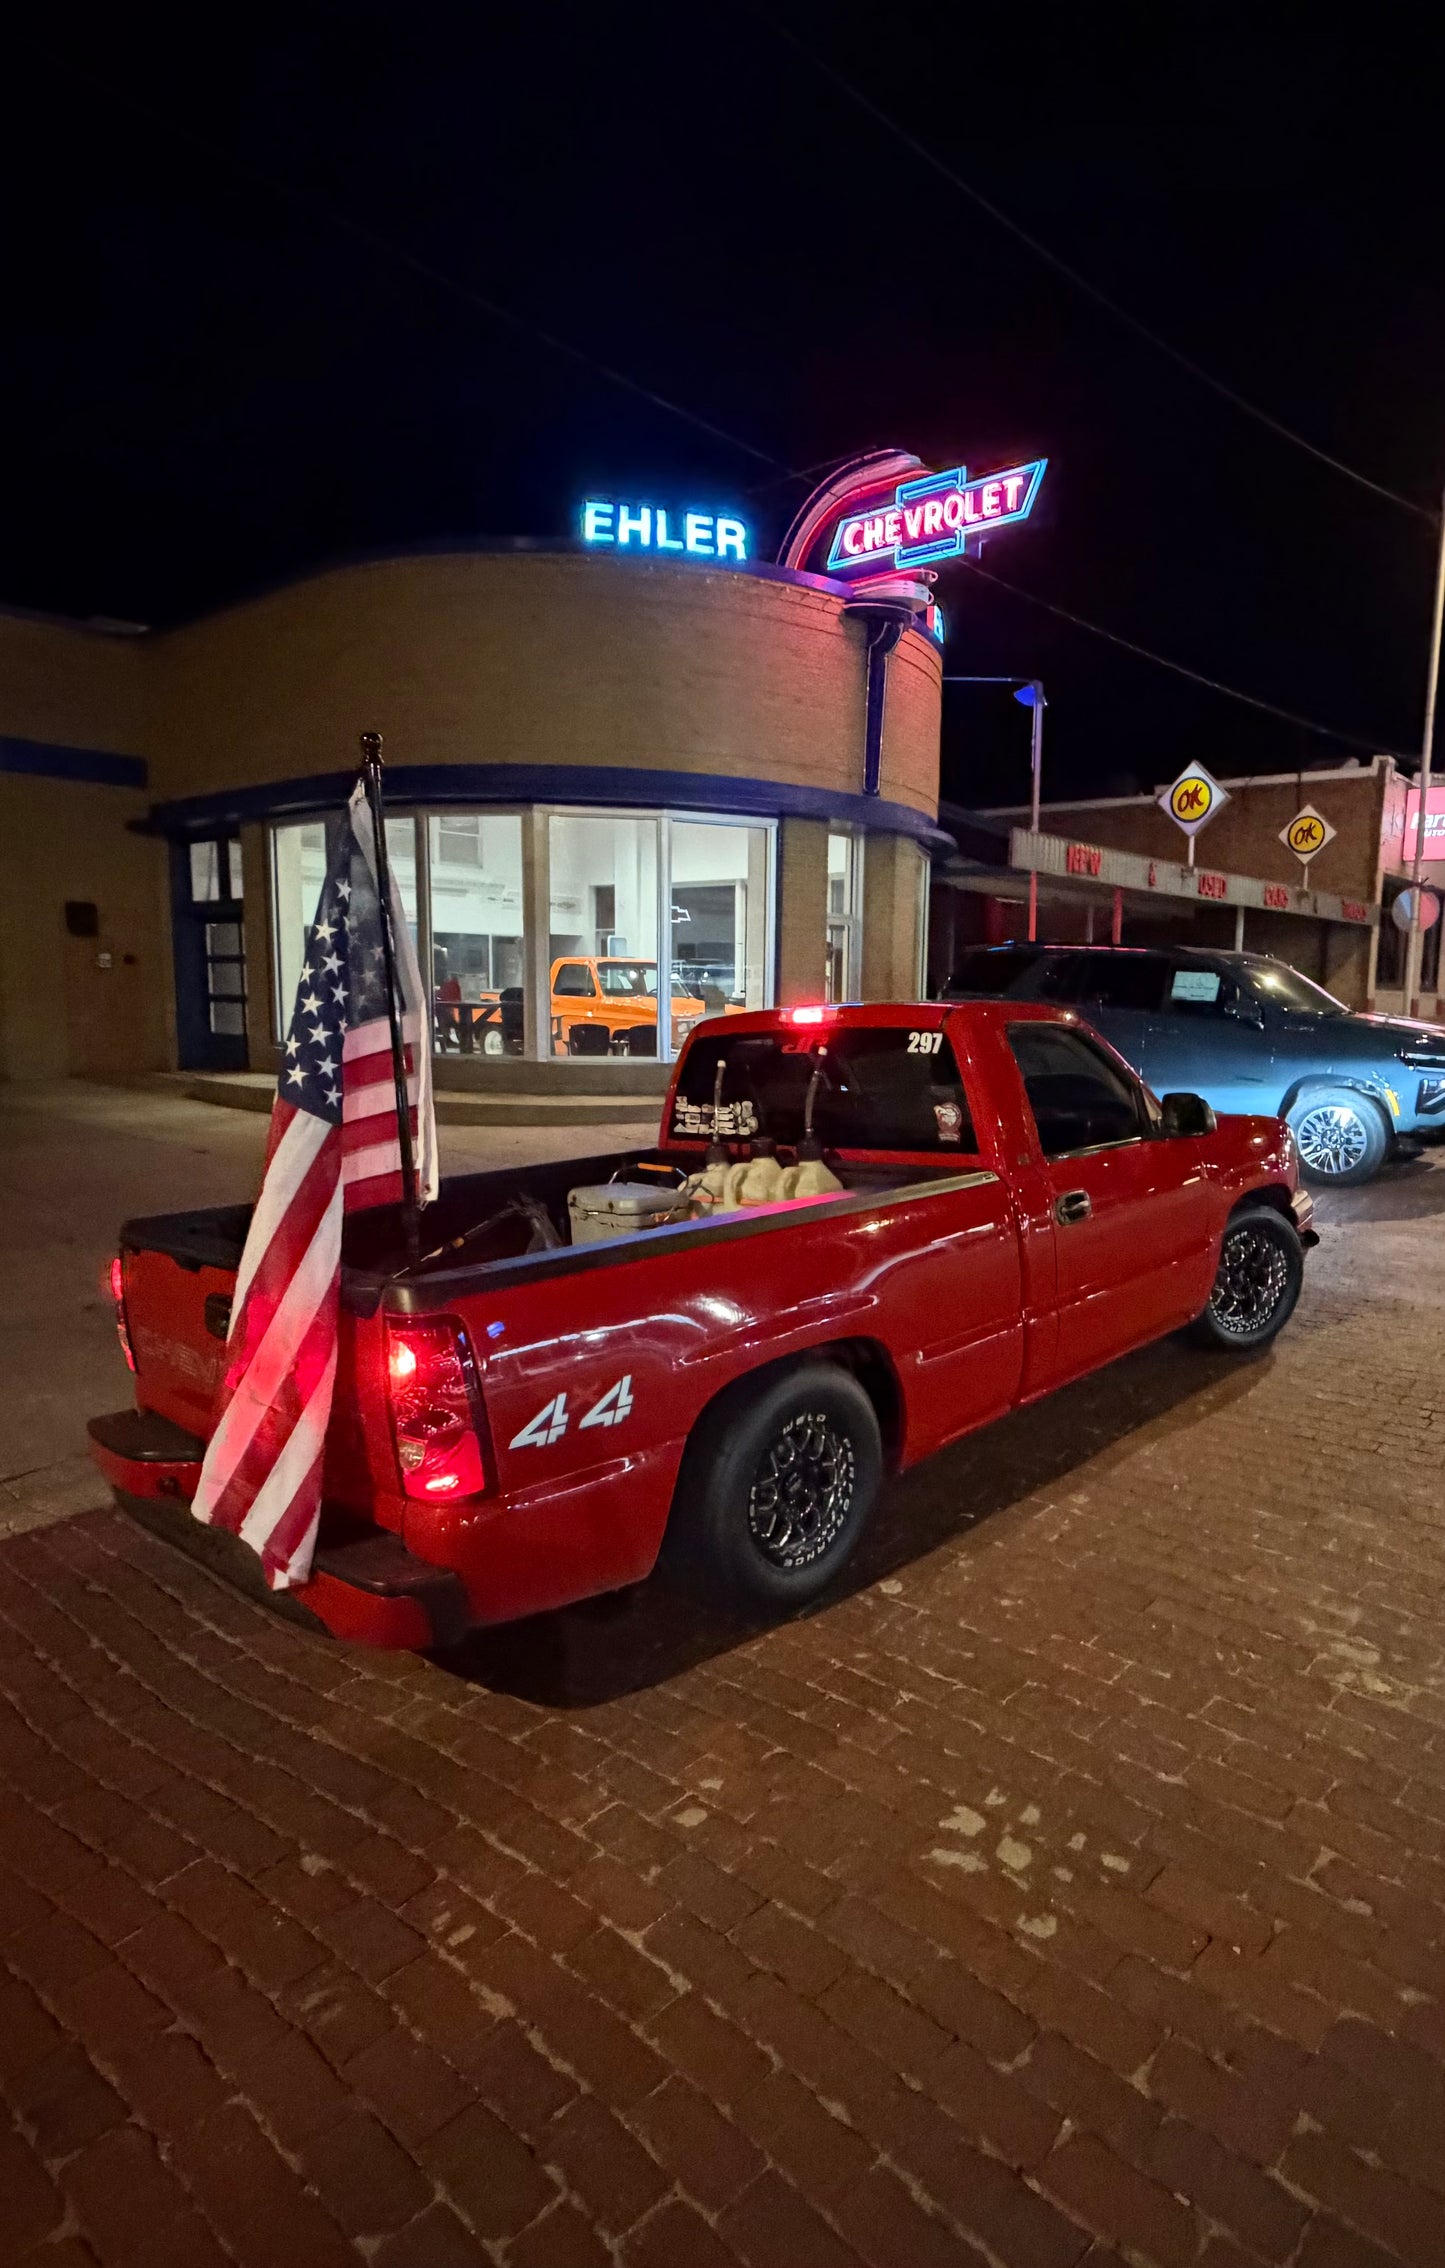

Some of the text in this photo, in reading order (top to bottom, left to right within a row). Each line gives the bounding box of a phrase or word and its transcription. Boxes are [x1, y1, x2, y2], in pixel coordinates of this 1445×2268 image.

[582, 499, 748, 560] EHLER
[843, 475, 1025, 556] CHEVROLET
[1178, 783, 1205, 813] OK
[1294, 822, 1317, 845] OK
[907, 1031, 943, 1054] 297
